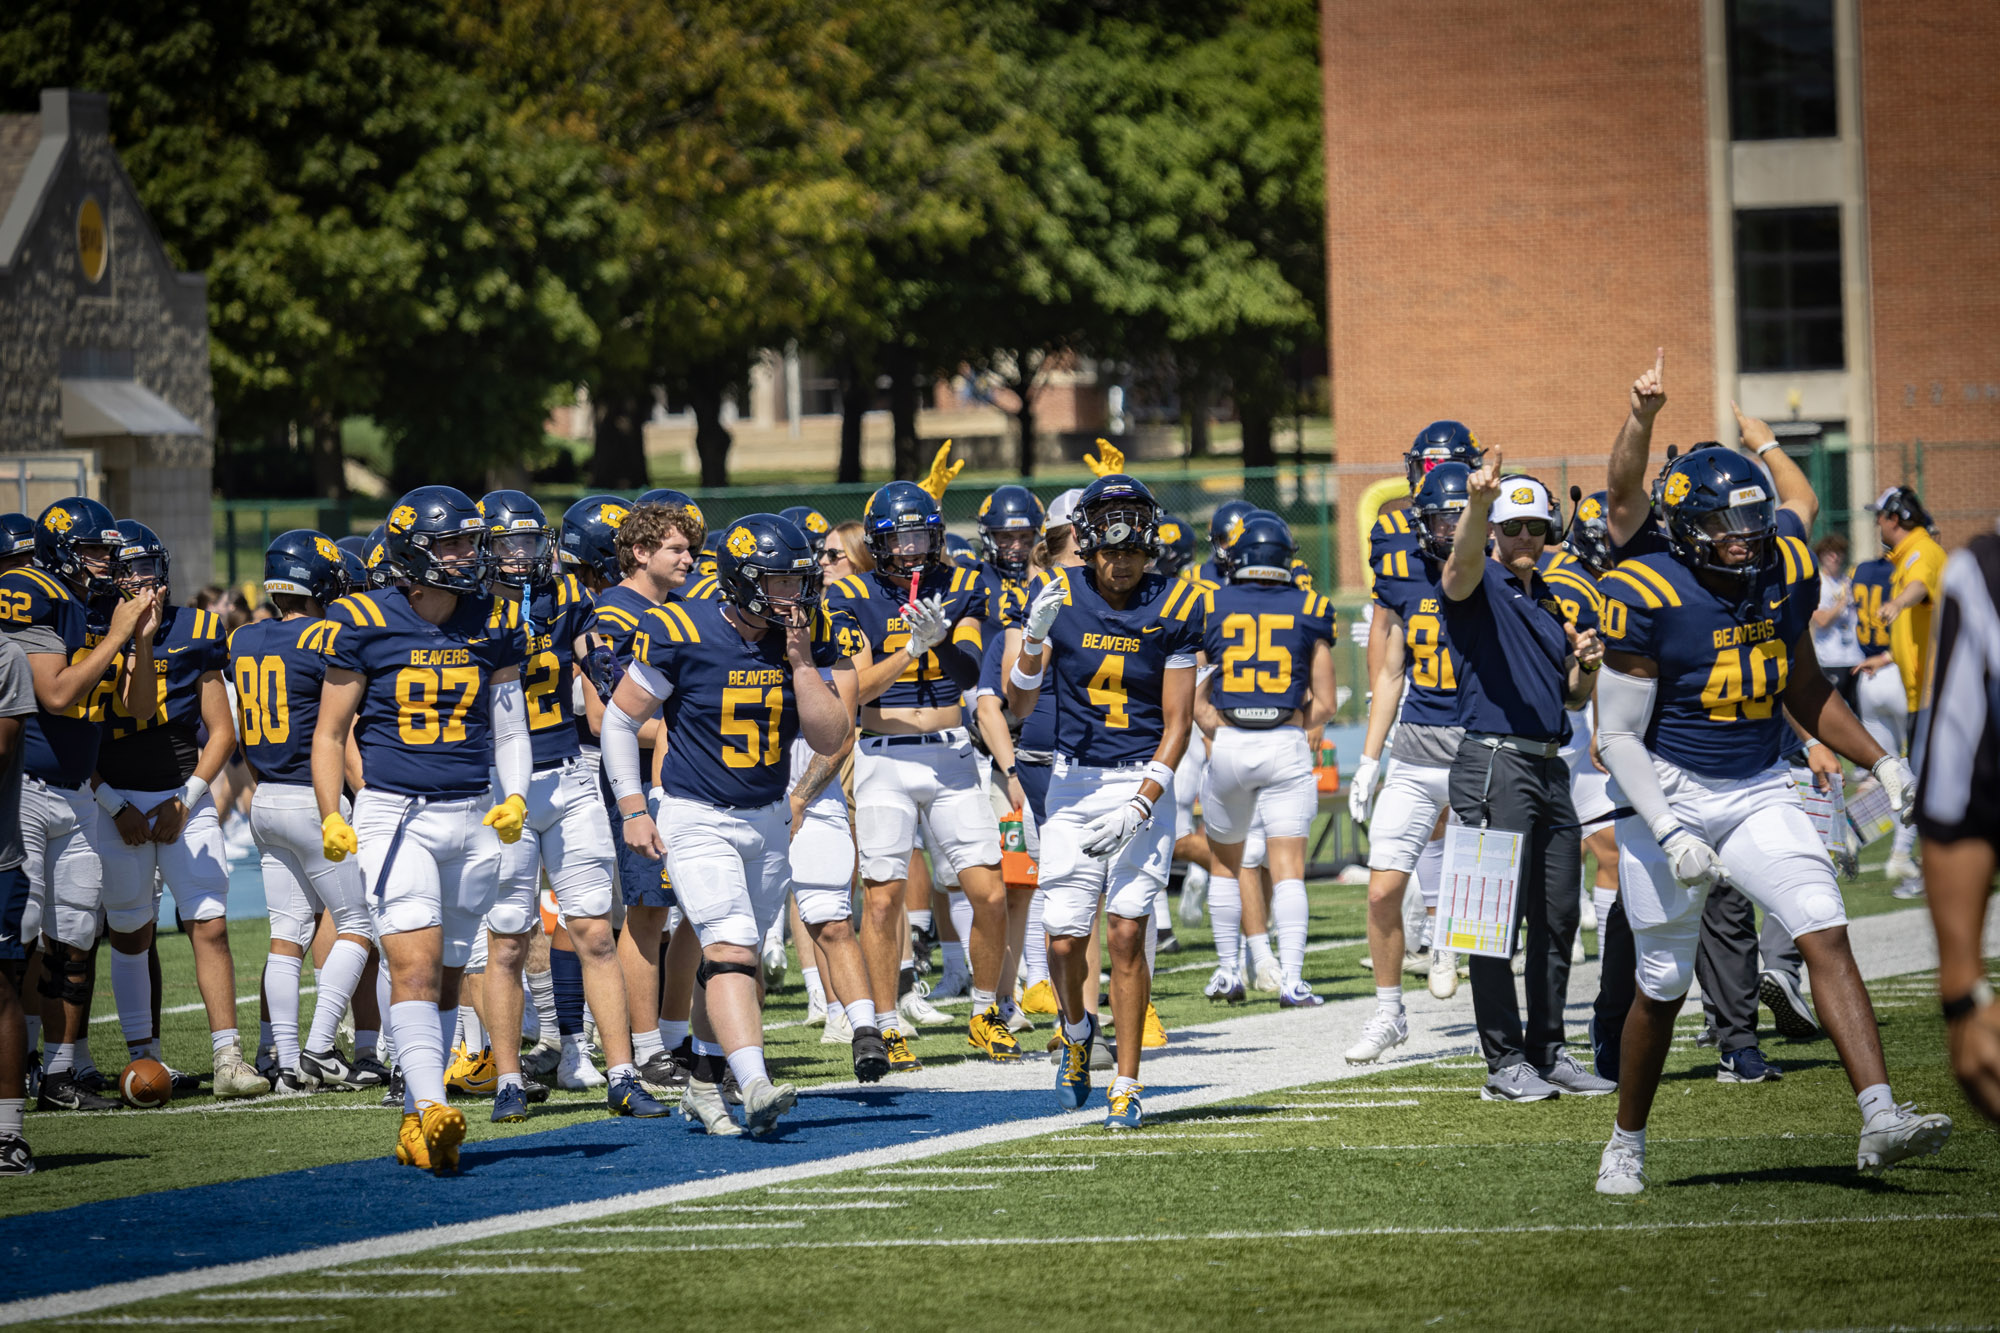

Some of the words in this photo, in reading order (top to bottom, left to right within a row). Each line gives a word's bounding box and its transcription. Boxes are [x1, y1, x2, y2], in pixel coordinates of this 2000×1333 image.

[1739, 490, 1756, 500] BVU
[264, 583, 294, 592] EAVERS
[0, 588, 33, 623] 62
[632, 631, 651, 666] 51
[1082, 633, 1140, 653] BEAVERS
[1712, 619, 1775, 649] BEAVERS
[411, 649, 469, 666] BEAVERS
[1222, 613, 1294, 693] 25
[728, 669, 784, 686] BEAVERS
[1087, 655, 1129, 728] 4
[1700, 638, 1788, 722] 40
[235, 655, 290, 745] 80
[395, 666, 480, 745] 87
[721, 686, 783, 768] 51
